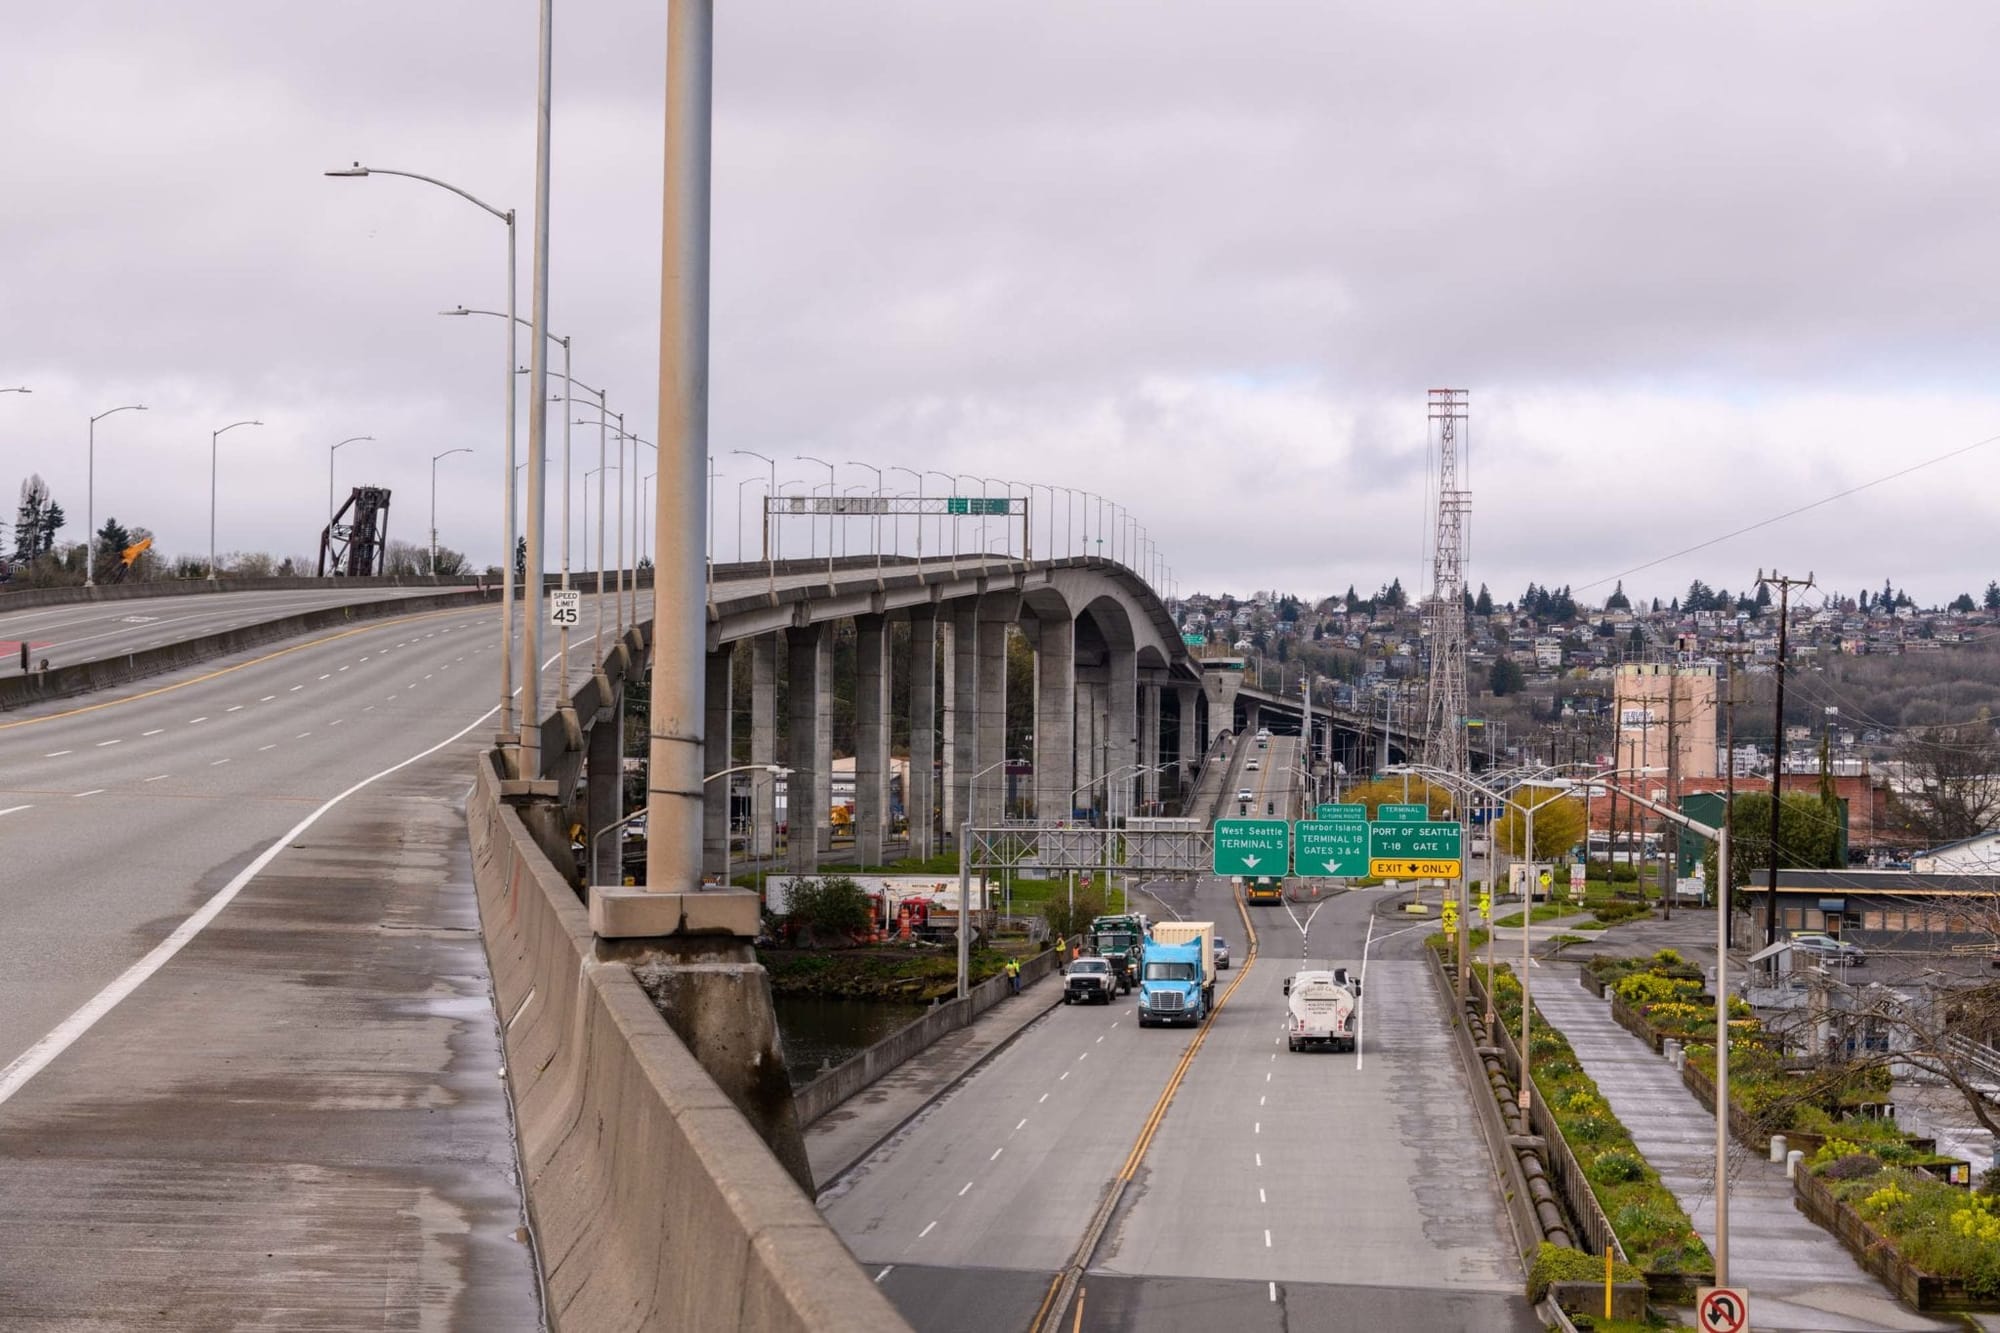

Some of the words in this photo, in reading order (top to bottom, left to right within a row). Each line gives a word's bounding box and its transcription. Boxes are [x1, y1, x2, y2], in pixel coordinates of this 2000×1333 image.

[553, 608, 577, 623] 45
[1221, 826, 1244, 835] West
[1248, 826, 1283, 836] Seattle
[1302, 823, 1333, 831] Harbor
[1335, 823, 1362, 832] Island
[1372, 827, 1397, 836] PORT
[1401, 827, 1414, 836] OF
[1418, 828, 1459, 836] SEATTLE
[1302, 835, 1350, 843] TERMINAL
[1353, 835, 1363, 843] 18
[1221, 839, 1273, 849] TERMINAL
[1276, 840, 1284, 849] 5
[1382, 842, 1401, 851] T-18
[1412, 842, 1438, 851] GATE
[1445, 842, 1450, 851] 1
[1304, 846, 1334, 855] GATES
[1337, 847, 1343, 855] 3
[1345, 847, 1351, 855] &
[1353, 847, 1360, 855] 4
[1377, 863, 1402, 873] EXIT
[1422, 864, 1453, 873] ONLY
